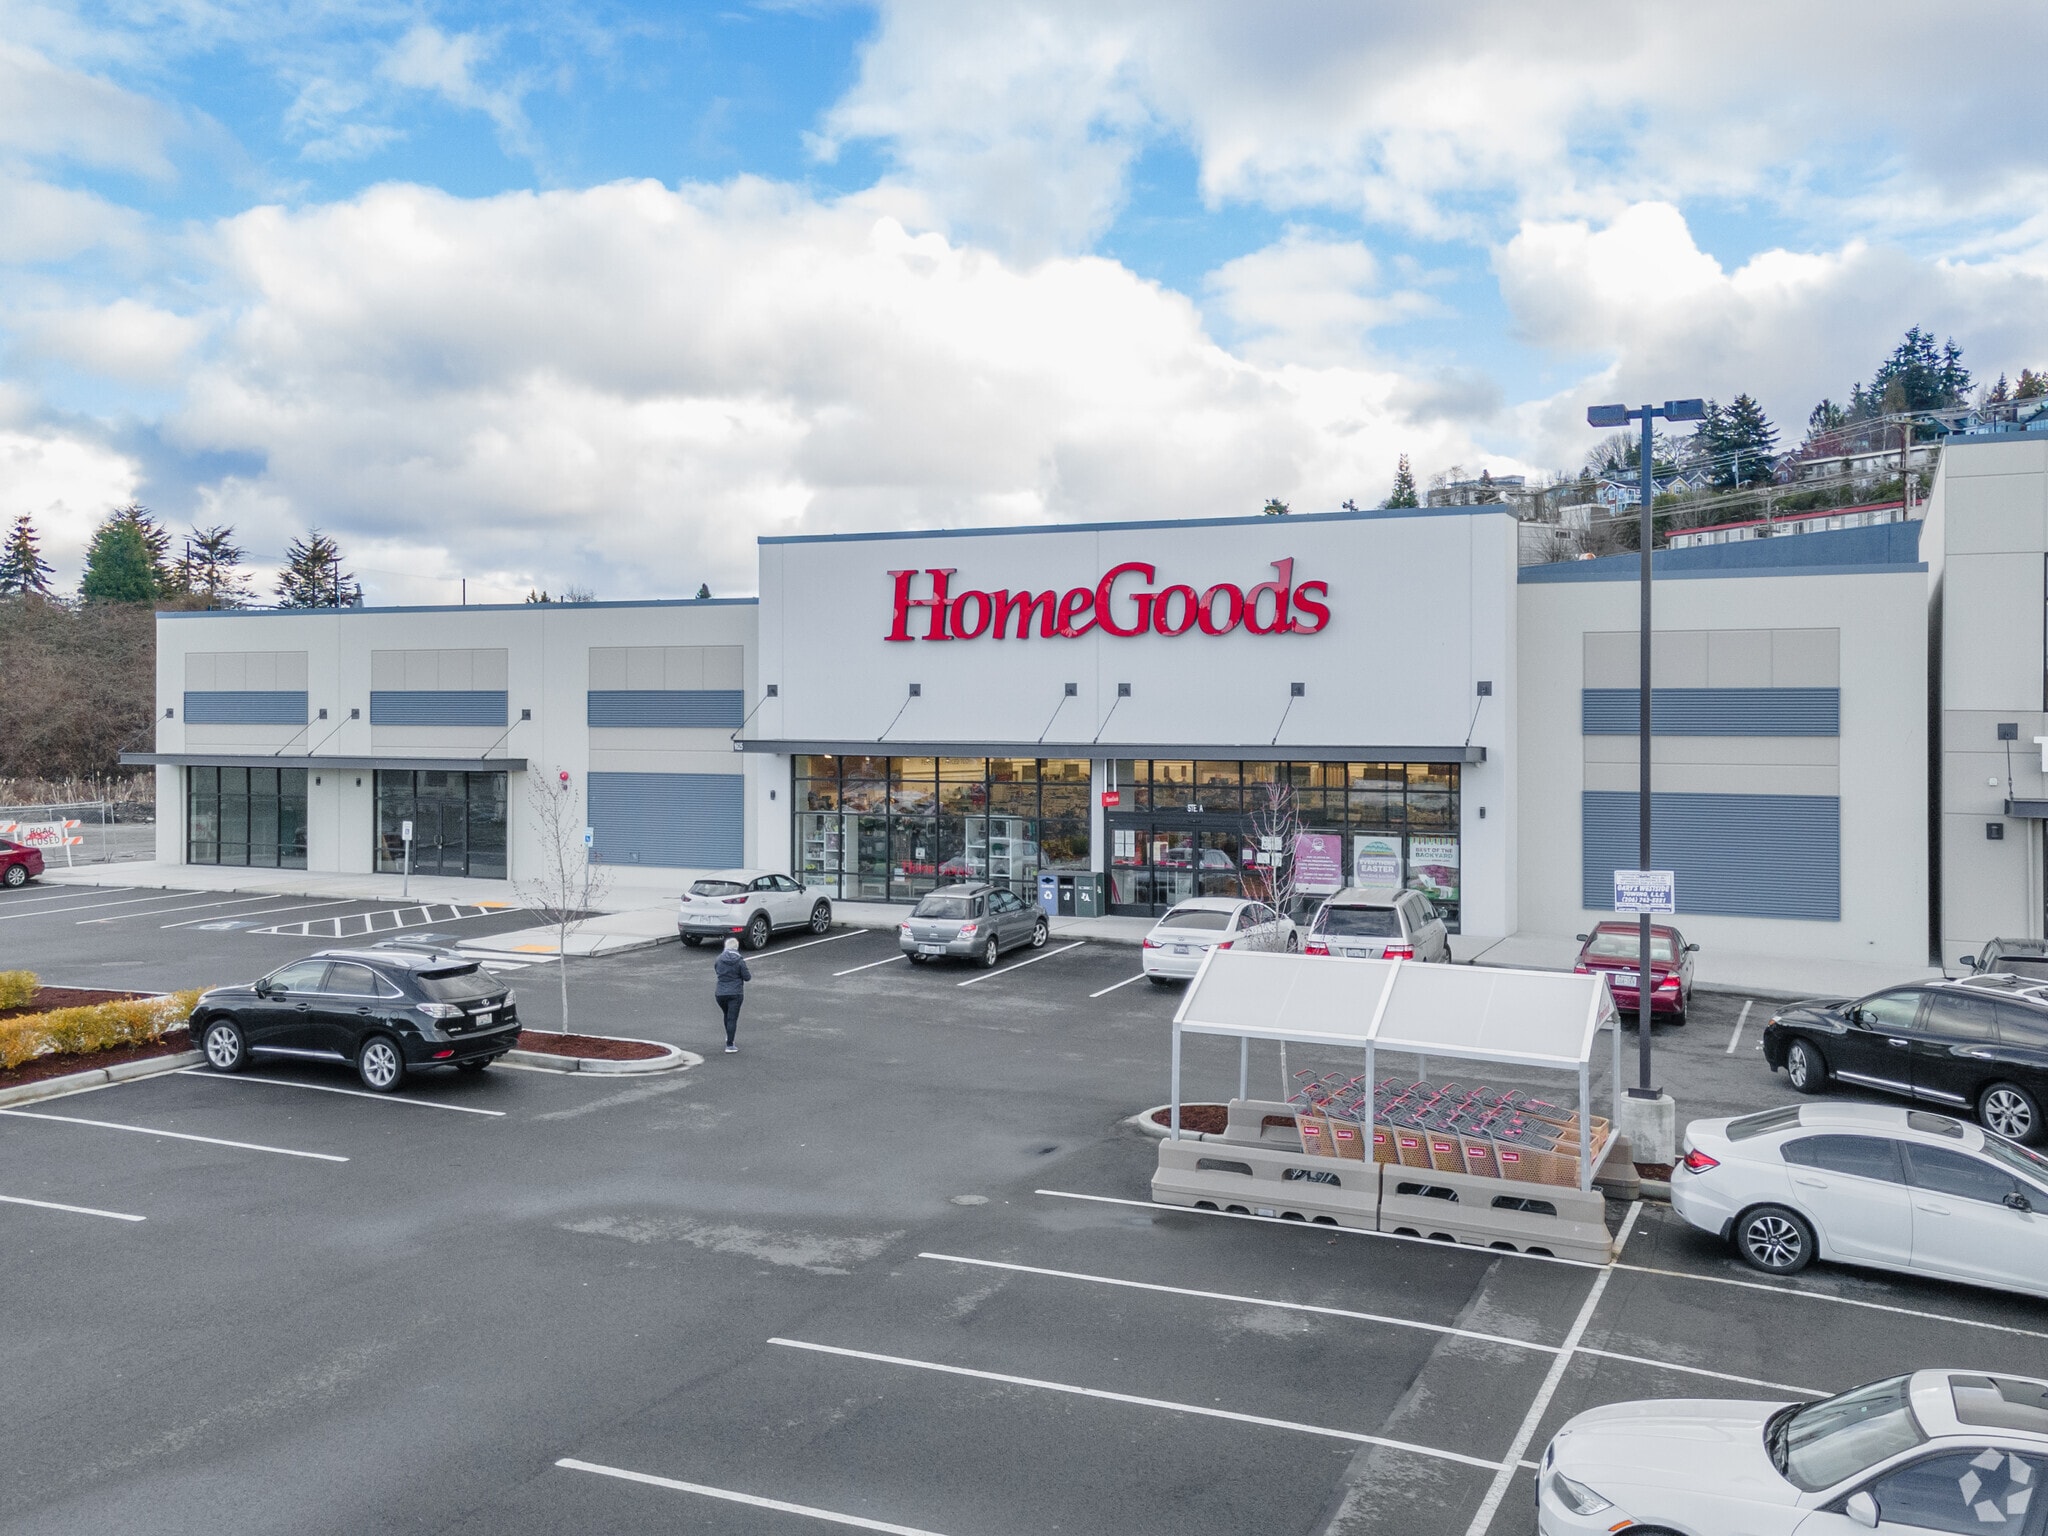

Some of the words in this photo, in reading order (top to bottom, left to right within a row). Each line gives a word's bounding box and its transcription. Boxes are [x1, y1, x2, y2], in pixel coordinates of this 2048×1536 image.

[884, 556, 1332, 643] HomeGoods
[1199, 803, 1204, 813] A
[30, 826, 54, 835] ROAD
[26, 837, 60, 846] CLOSED
[1361, 865, 1394, 873] EASTER
